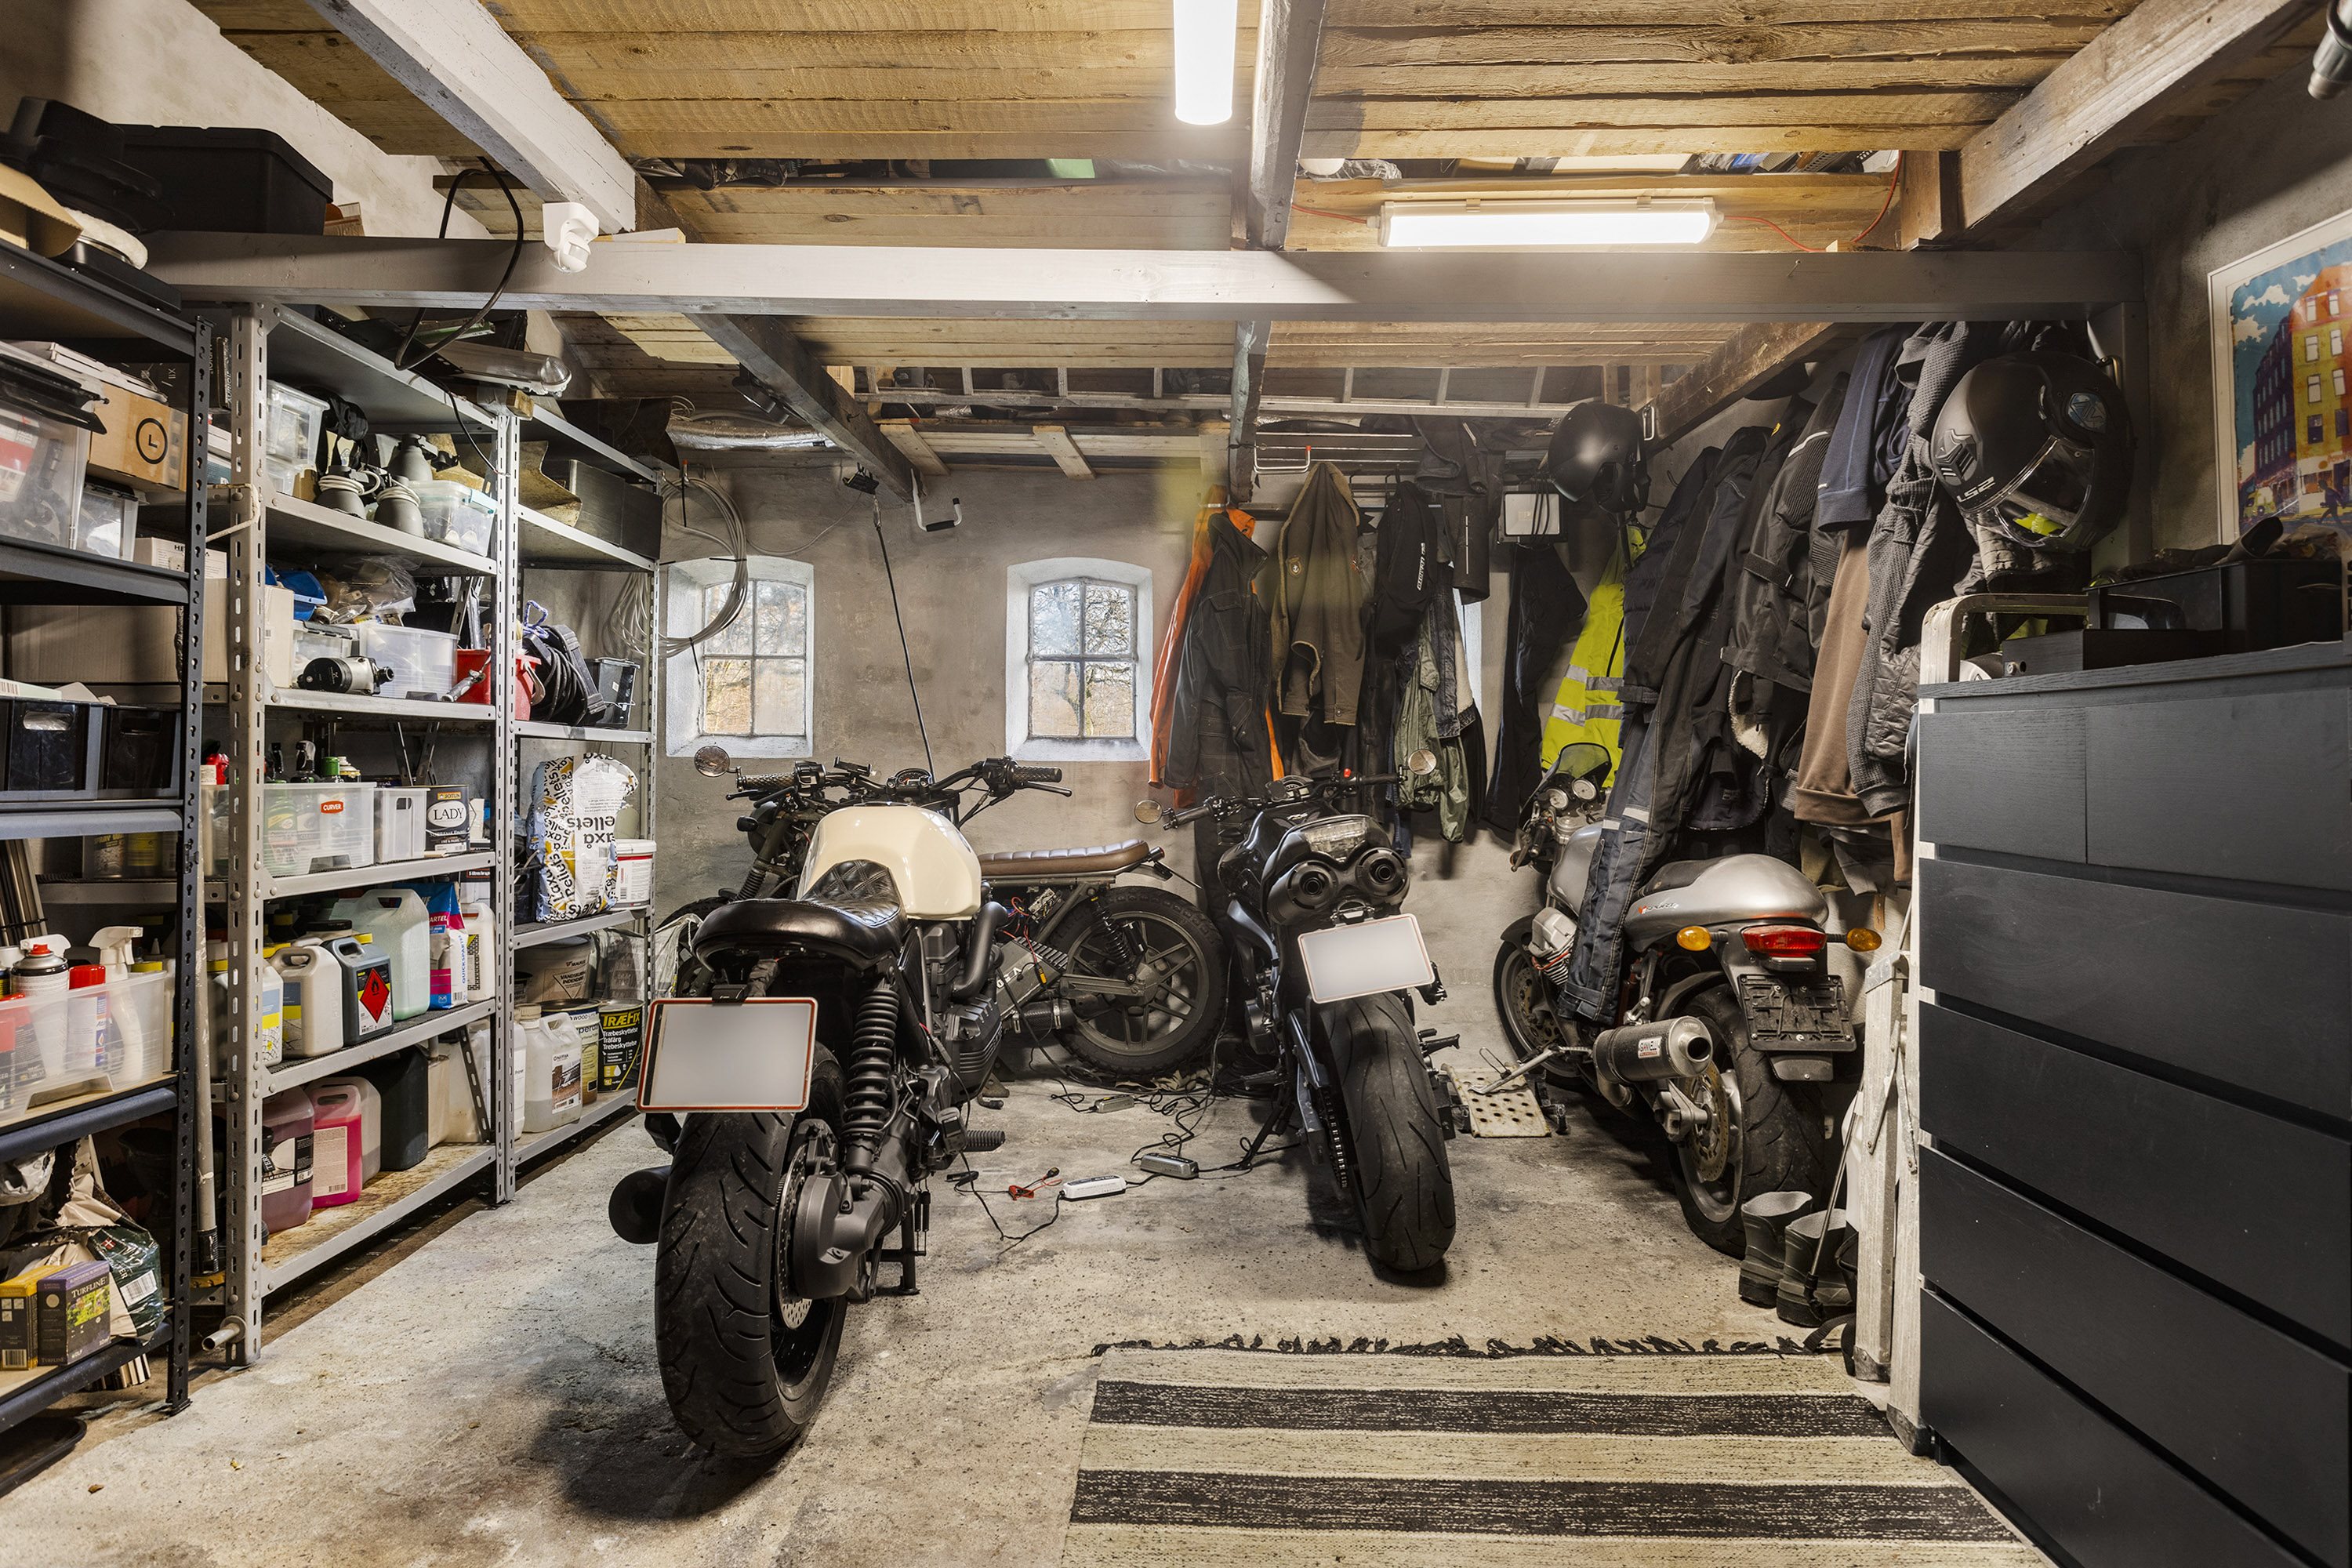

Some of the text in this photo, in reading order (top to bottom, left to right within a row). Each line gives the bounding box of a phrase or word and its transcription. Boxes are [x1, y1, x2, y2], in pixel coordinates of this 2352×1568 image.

[1956, 476, 1995, 503] LS2
[434, 808, 464, 820] LADY
[566, 815, 615, 831] ellets
[583, 831, 615, 849] axå
[603, 1011, 640, 1027] TRÆFIX
[603, 1040, 637, 1050] Trebeskyttelse
[72, 1279, 105, 1298] TURFLINE
